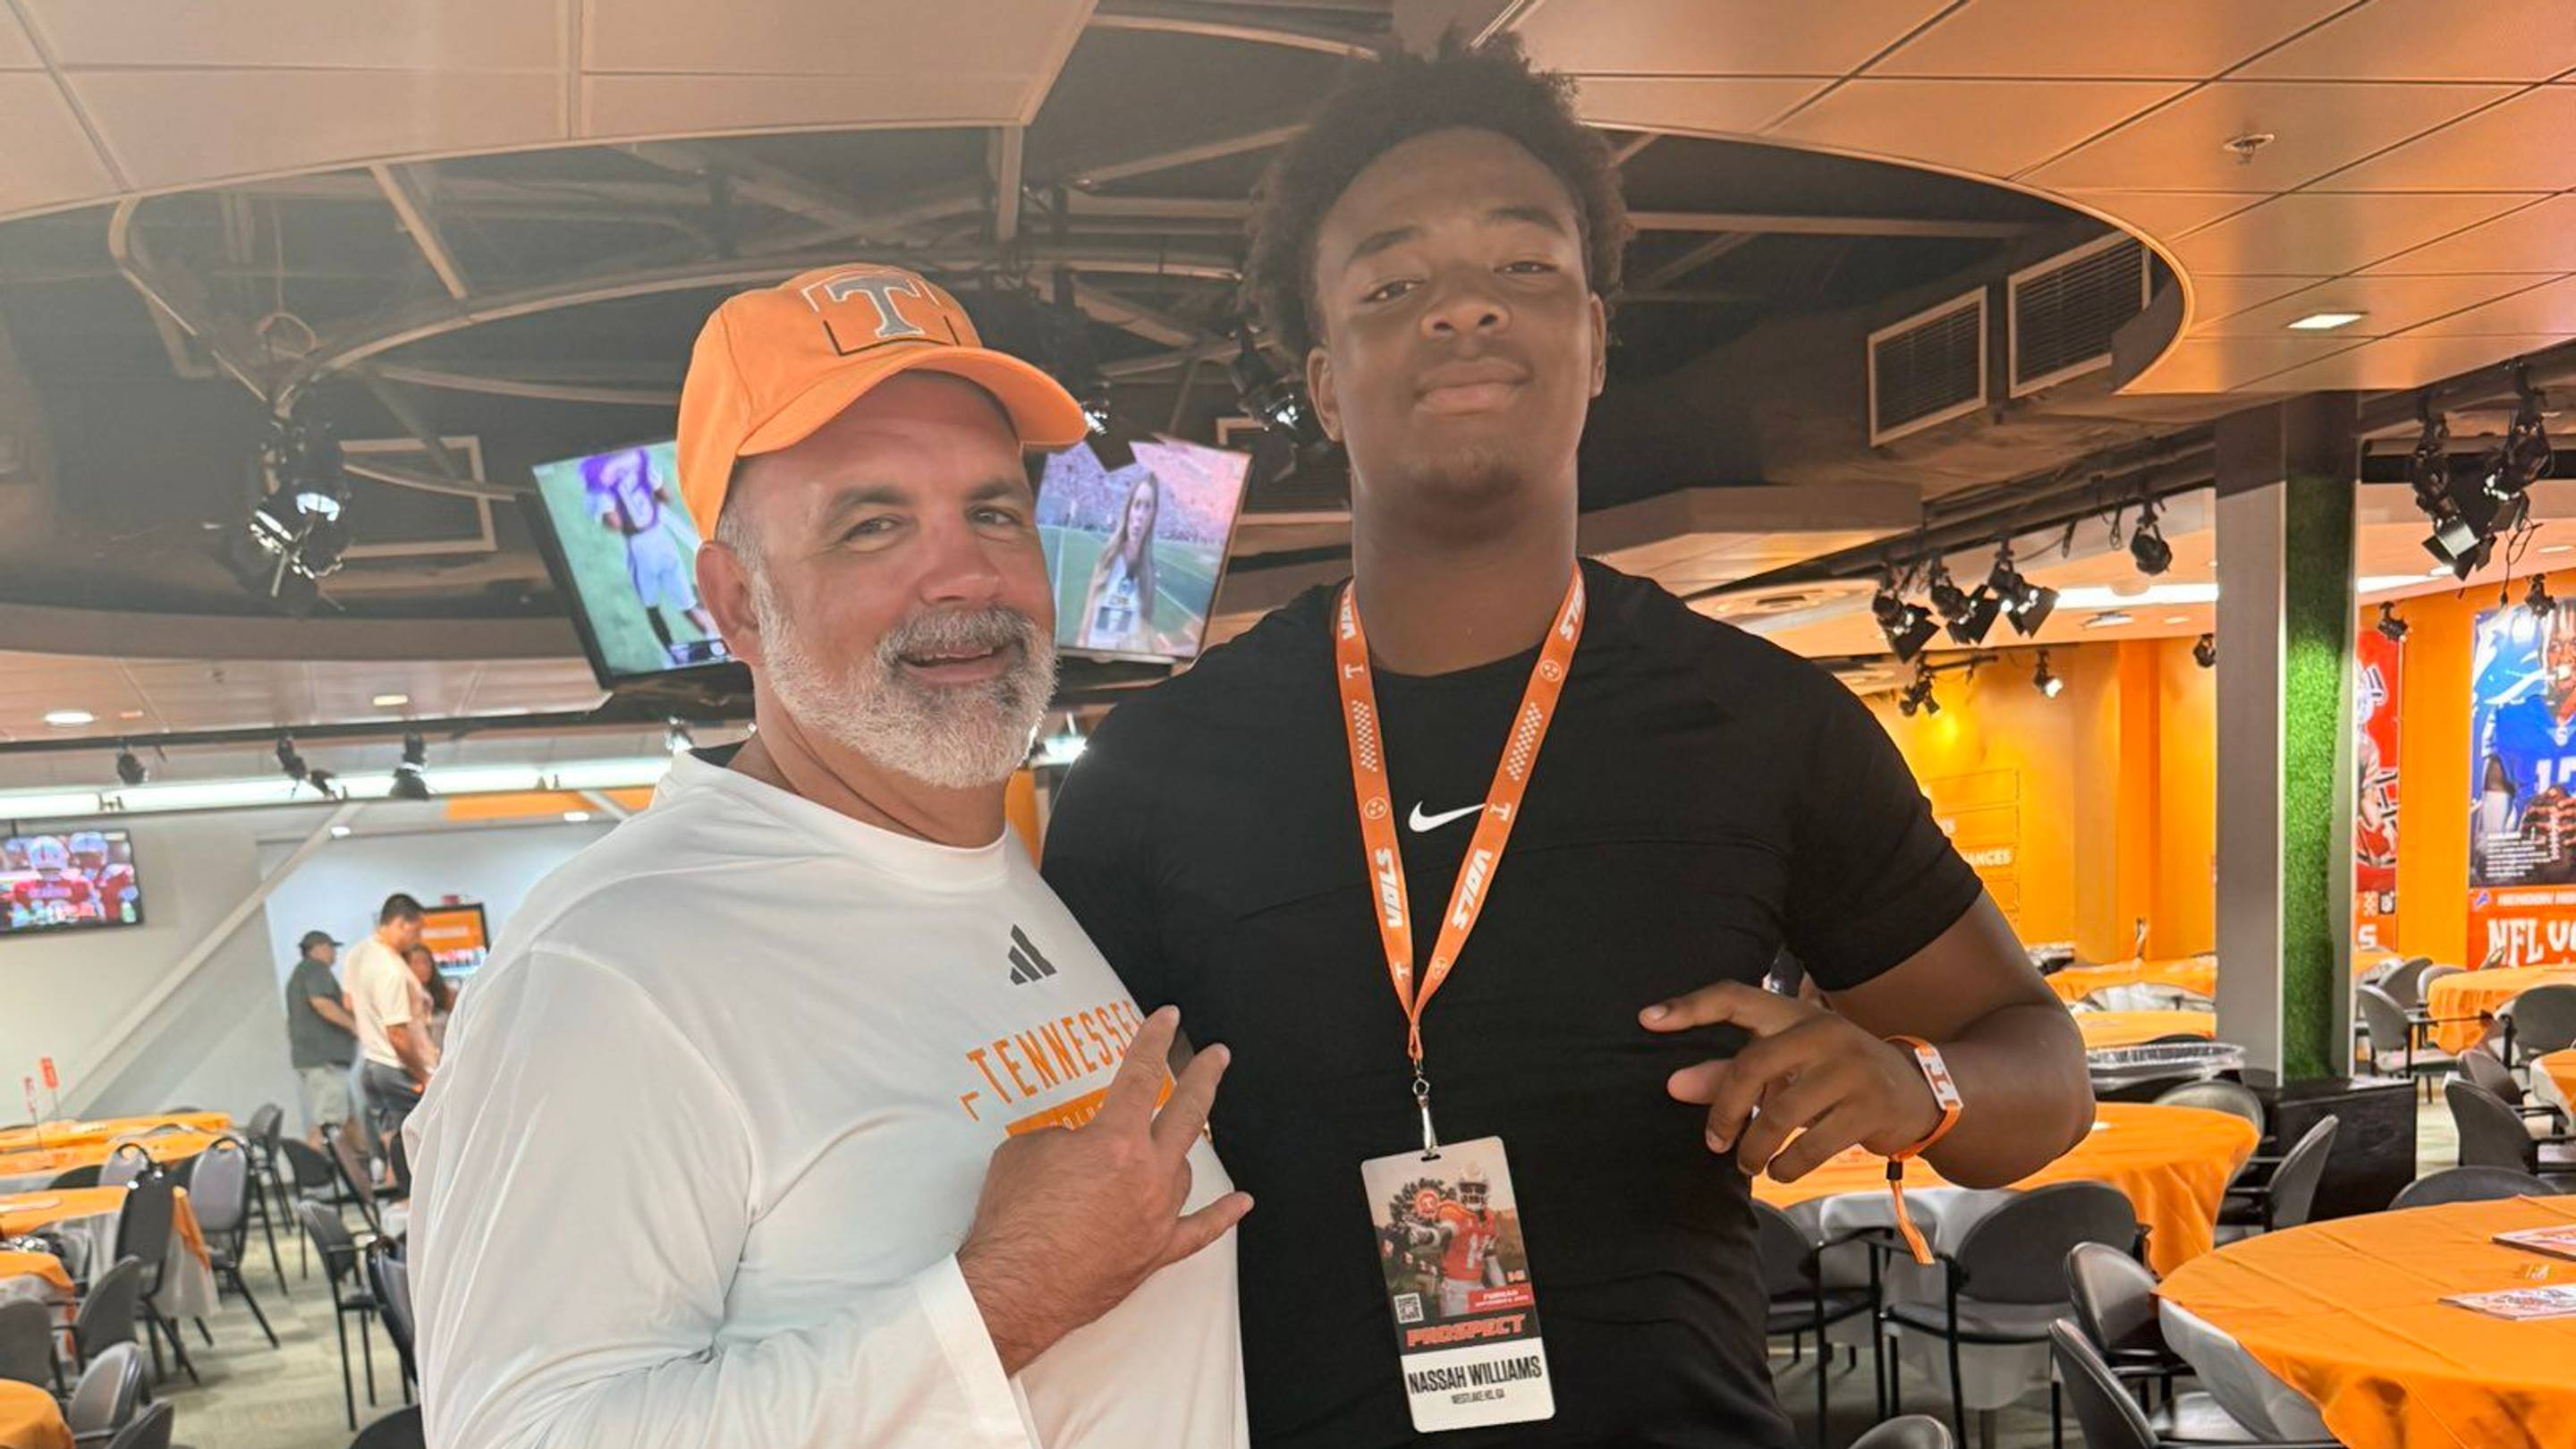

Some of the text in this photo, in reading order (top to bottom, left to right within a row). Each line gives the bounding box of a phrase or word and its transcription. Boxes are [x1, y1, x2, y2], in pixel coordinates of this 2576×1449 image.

[824, 275, 925, 337] T
[1962, 849, 2012, 866] ANCES
[1375, 848, 1403, 928] VOLS
[1452, 849, 1493, 930] VOLS
[2487, 919, 2544, 968] NFL
[1406, 1314, 1526, 1347] PROSPECT
[1408, 1355, 1542, 1394] NASSAH WILLIAMS
